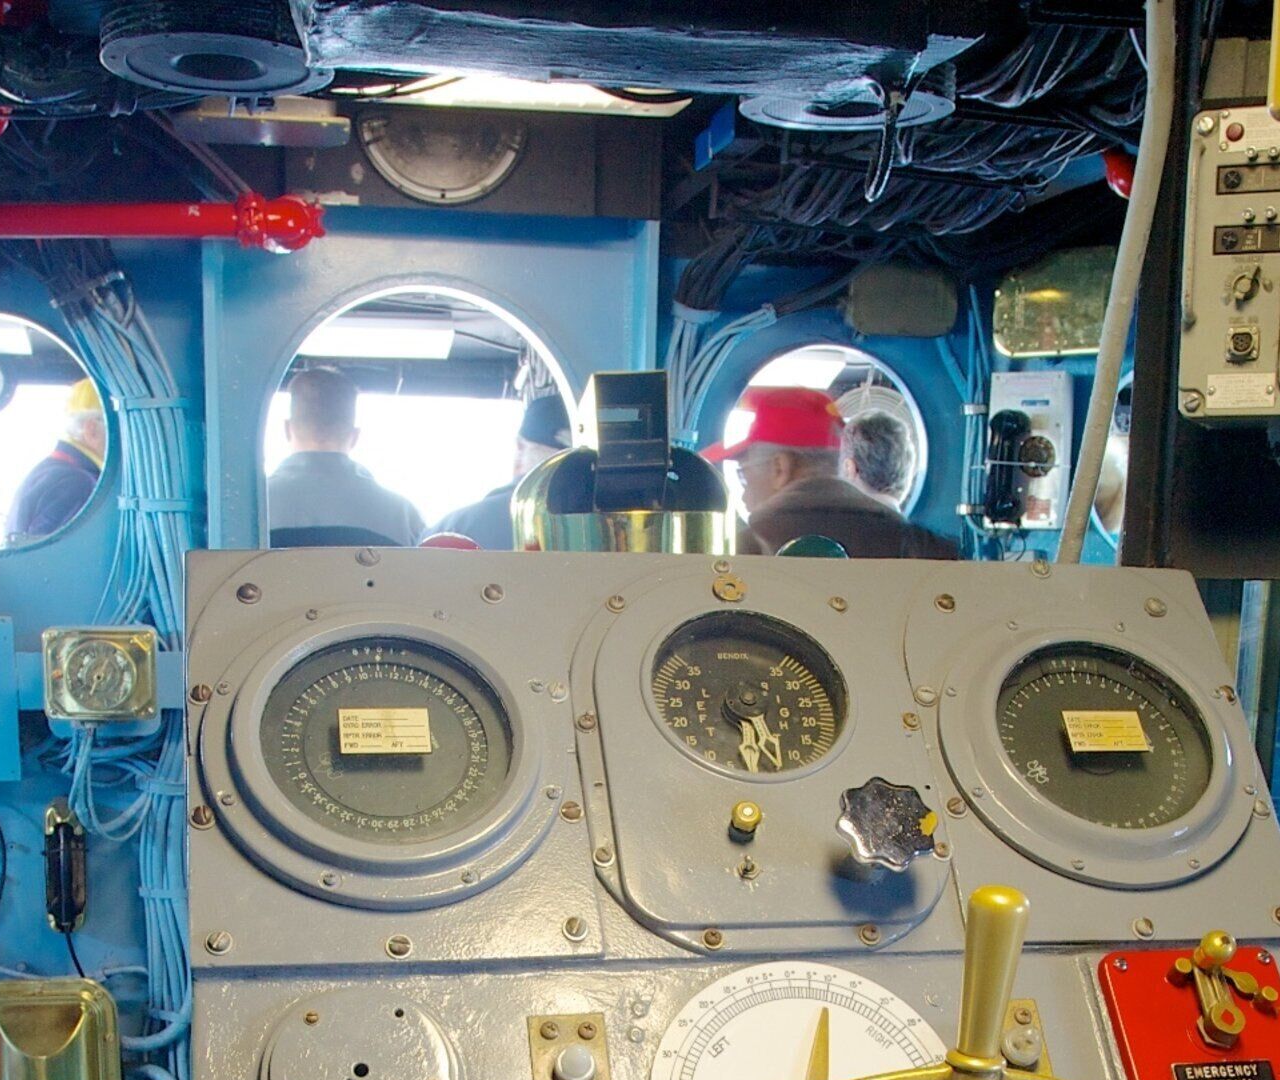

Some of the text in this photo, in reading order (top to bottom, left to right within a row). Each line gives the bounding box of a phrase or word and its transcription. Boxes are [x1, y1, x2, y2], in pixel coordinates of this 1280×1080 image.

[687, 666, 701, 676] 35
[769, 667, 783, 677] 35
[675, 680, 691, 690] 30
[785, 680, 800, 690] 30
[669, 698, 683, 708] 25
[798, 697, 813, 708] 25
[673, 717, 688, 728] 20
[802, 717, 817, 727] 20
[685, 735, 698, 746] 15
[800, 734, 812, 745] 15
[704, 750, 716, 761] 10
[788, 750, 800, 760] 10
[865, 1026, 894, 1050] RIGHT
[707, 1036, 731, 1058] LEFT
[1185, 1064, 1258, 1079] EMERGENCY
